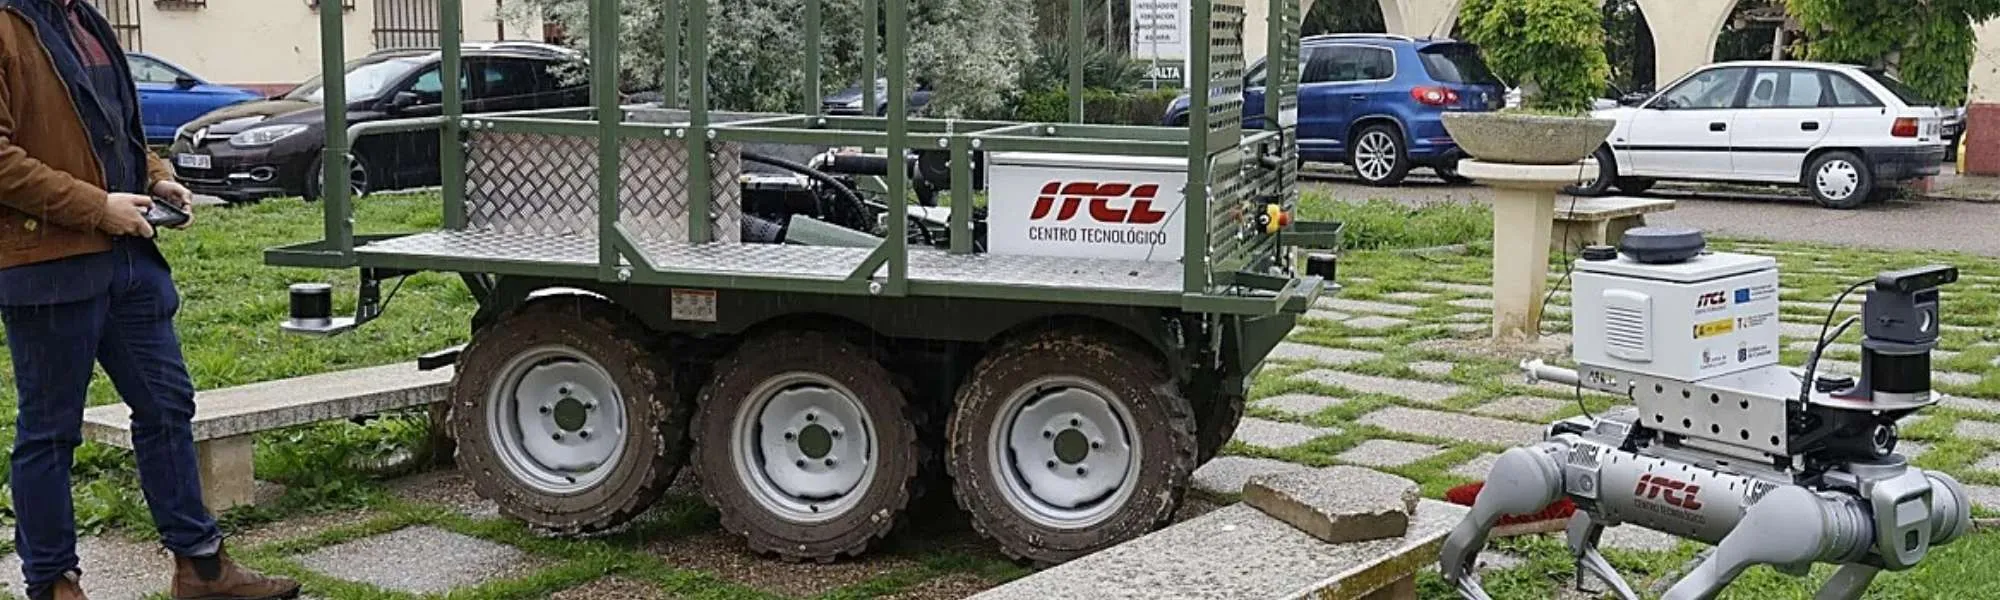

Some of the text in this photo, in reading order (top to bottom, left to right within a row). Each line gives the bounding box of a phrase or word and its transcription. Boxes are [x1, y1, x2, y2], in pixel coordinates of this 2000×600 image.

[1030, 182, 1166, 224] ITCL
[1029, 226, 1167, 245] CENTRO TECNOLÓGICO
[1697, 290, 1726, 308] ITCL
[1635, 474, 1702, 510] ITCL
